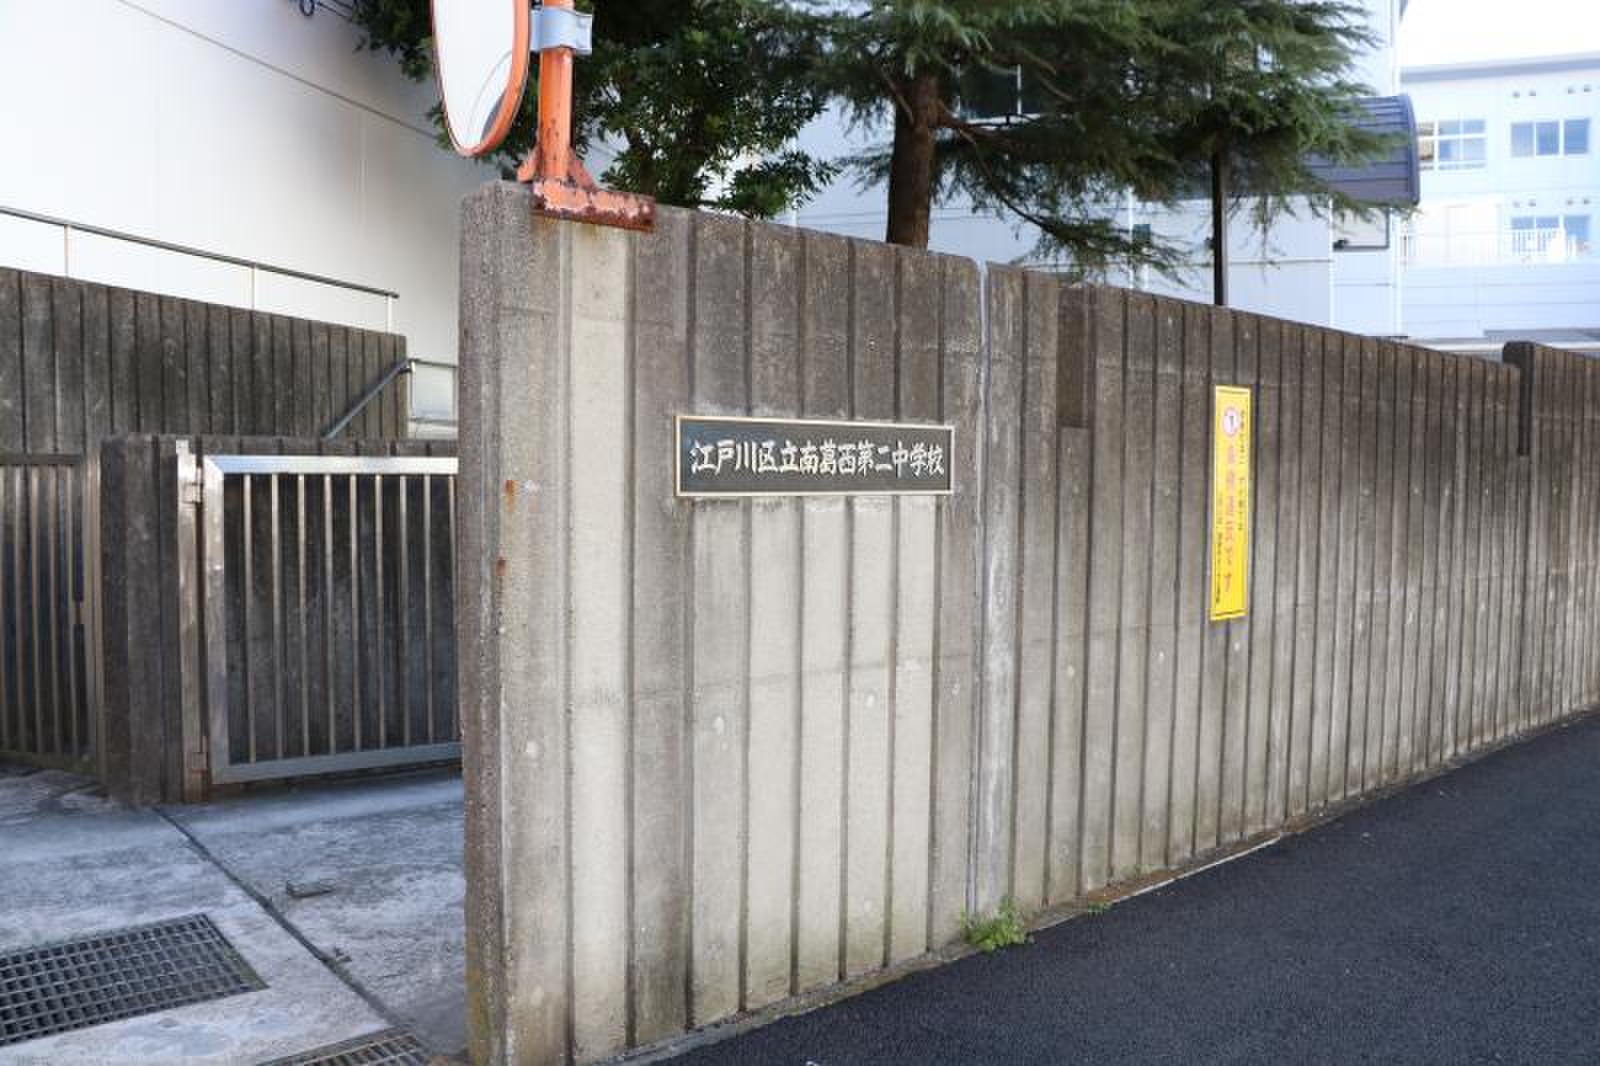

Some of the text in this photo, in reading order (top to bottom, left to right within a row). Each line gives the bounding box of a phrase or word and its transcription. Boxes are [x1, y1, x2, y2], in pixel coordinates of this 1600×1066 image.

[689, 439, 945, 477] 江戸川区立南葛西第二中学校
